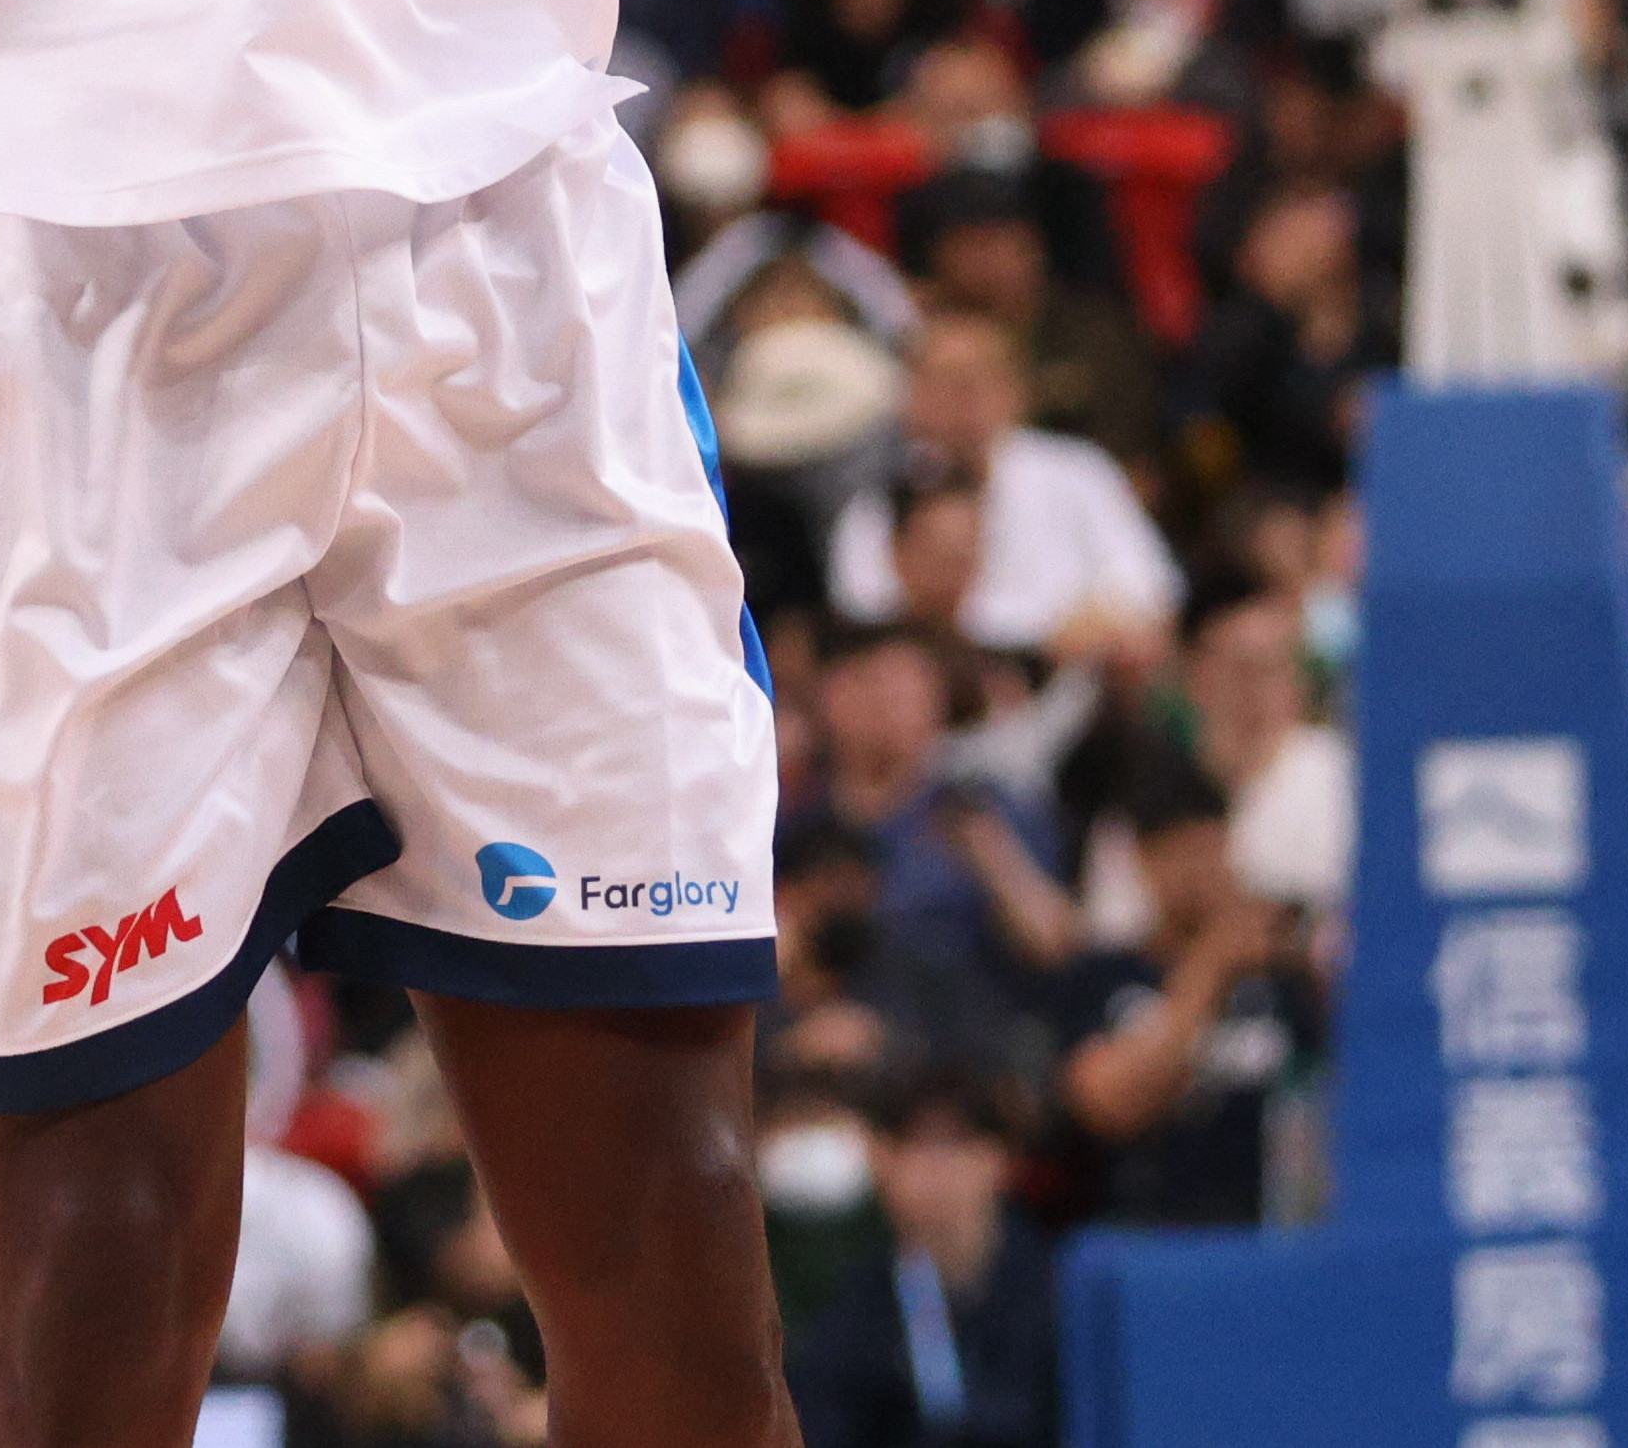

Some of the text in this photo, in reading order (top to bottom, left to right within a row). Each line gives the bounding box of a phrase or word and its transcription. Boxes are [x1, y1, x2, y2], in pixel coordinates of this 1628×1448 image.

[42, 884, 205, 1007] SYM
[580, 870, 740, 917] Farglory
[1429, 905, 1610, 1448] 信義房
